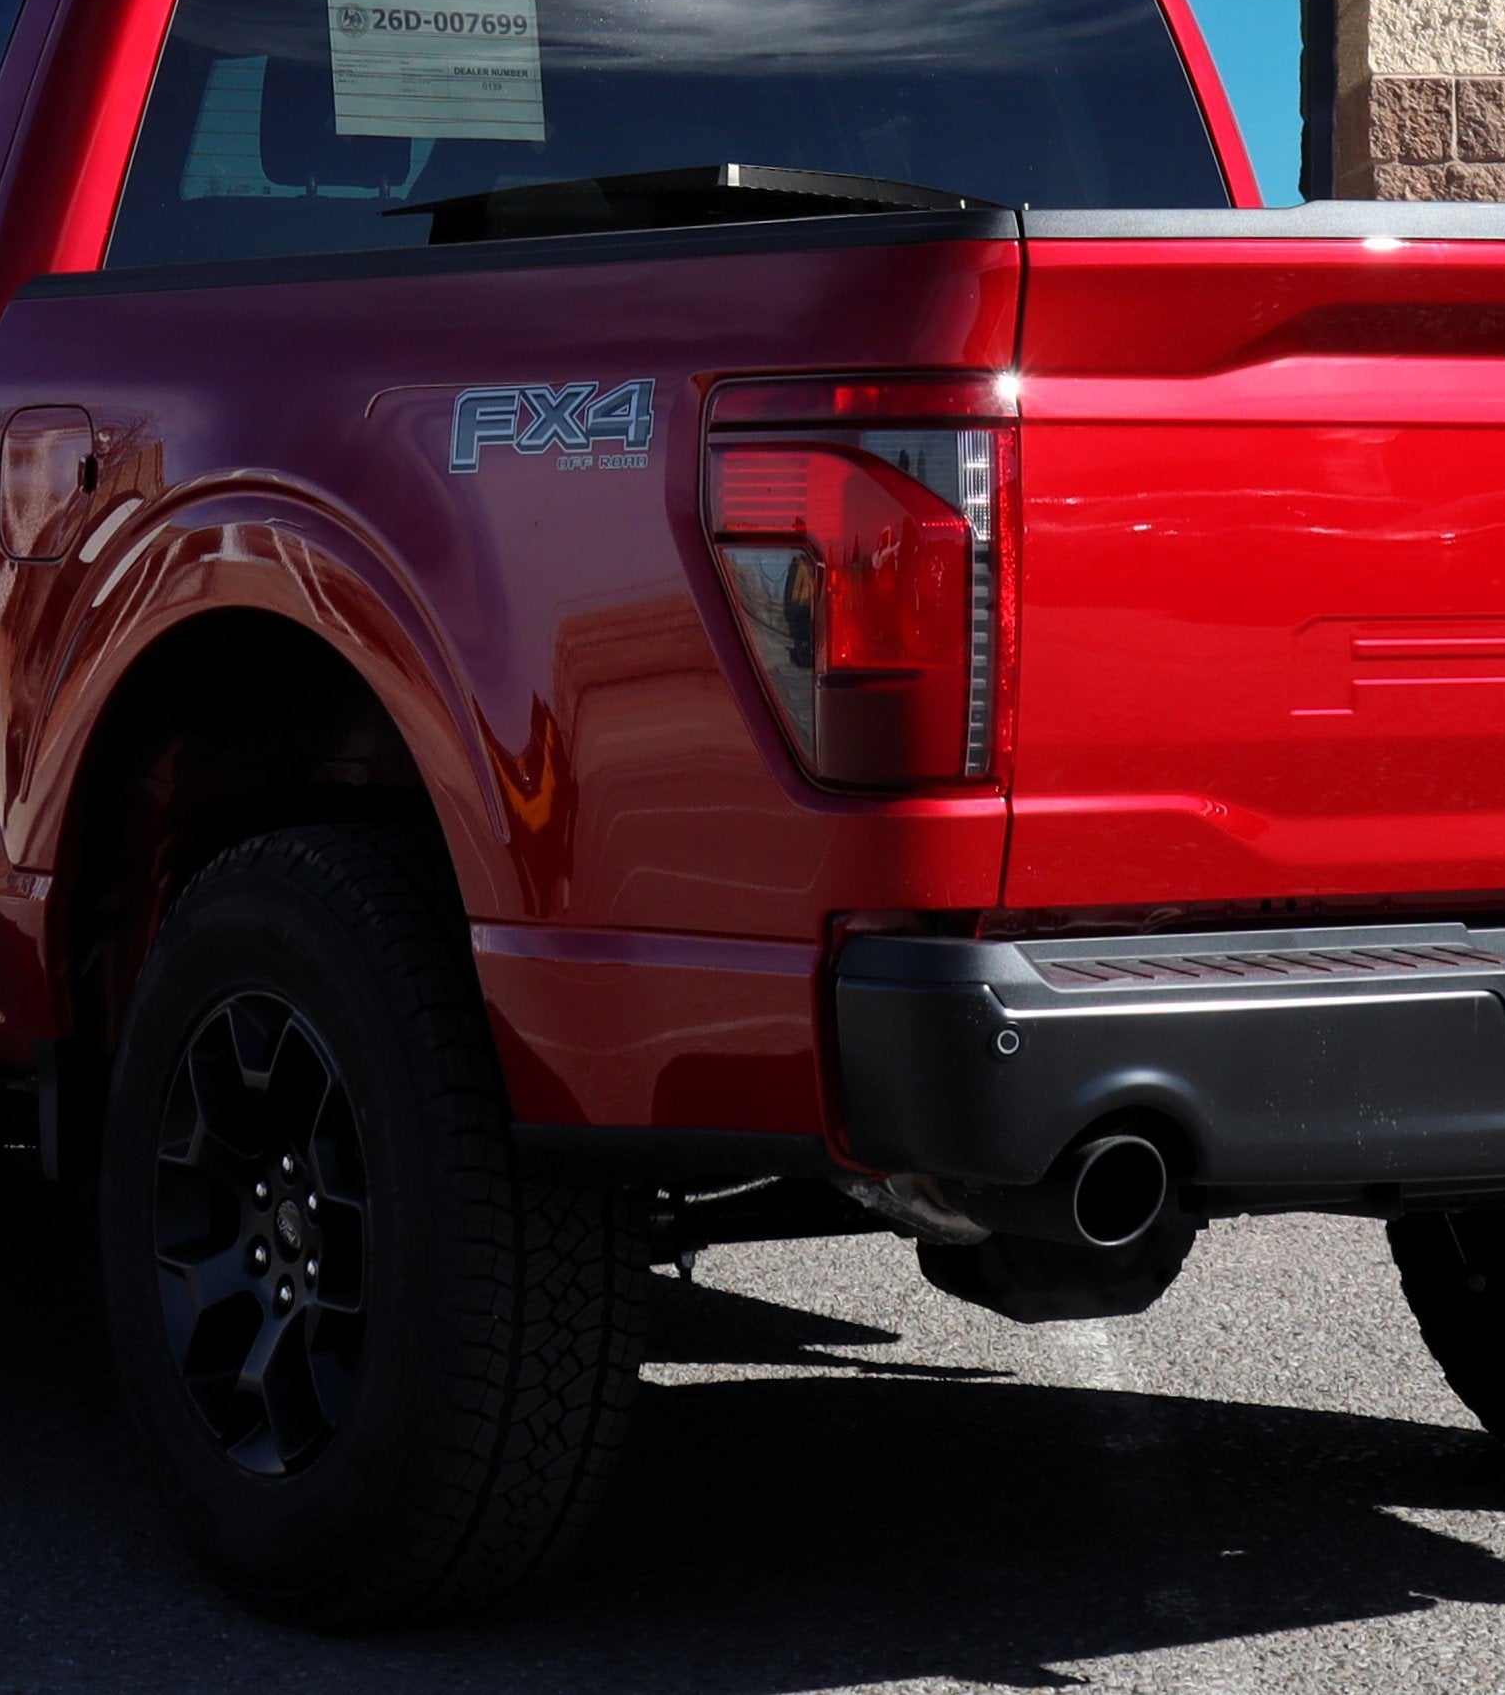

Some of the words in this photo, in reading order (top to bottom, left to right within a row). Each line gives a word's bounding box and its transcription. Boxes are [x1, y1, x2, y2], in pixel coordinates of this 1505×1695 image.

[371, 8, 528, 36] 26D-007699
[453, 67, 489, 77] DEALER
[490, 68, 528, 78] NUMBER
[449, 378, 656, 474] FX4
[556, 455, 593, 471] OFF
[599, 454, 649, 469] ROAD
